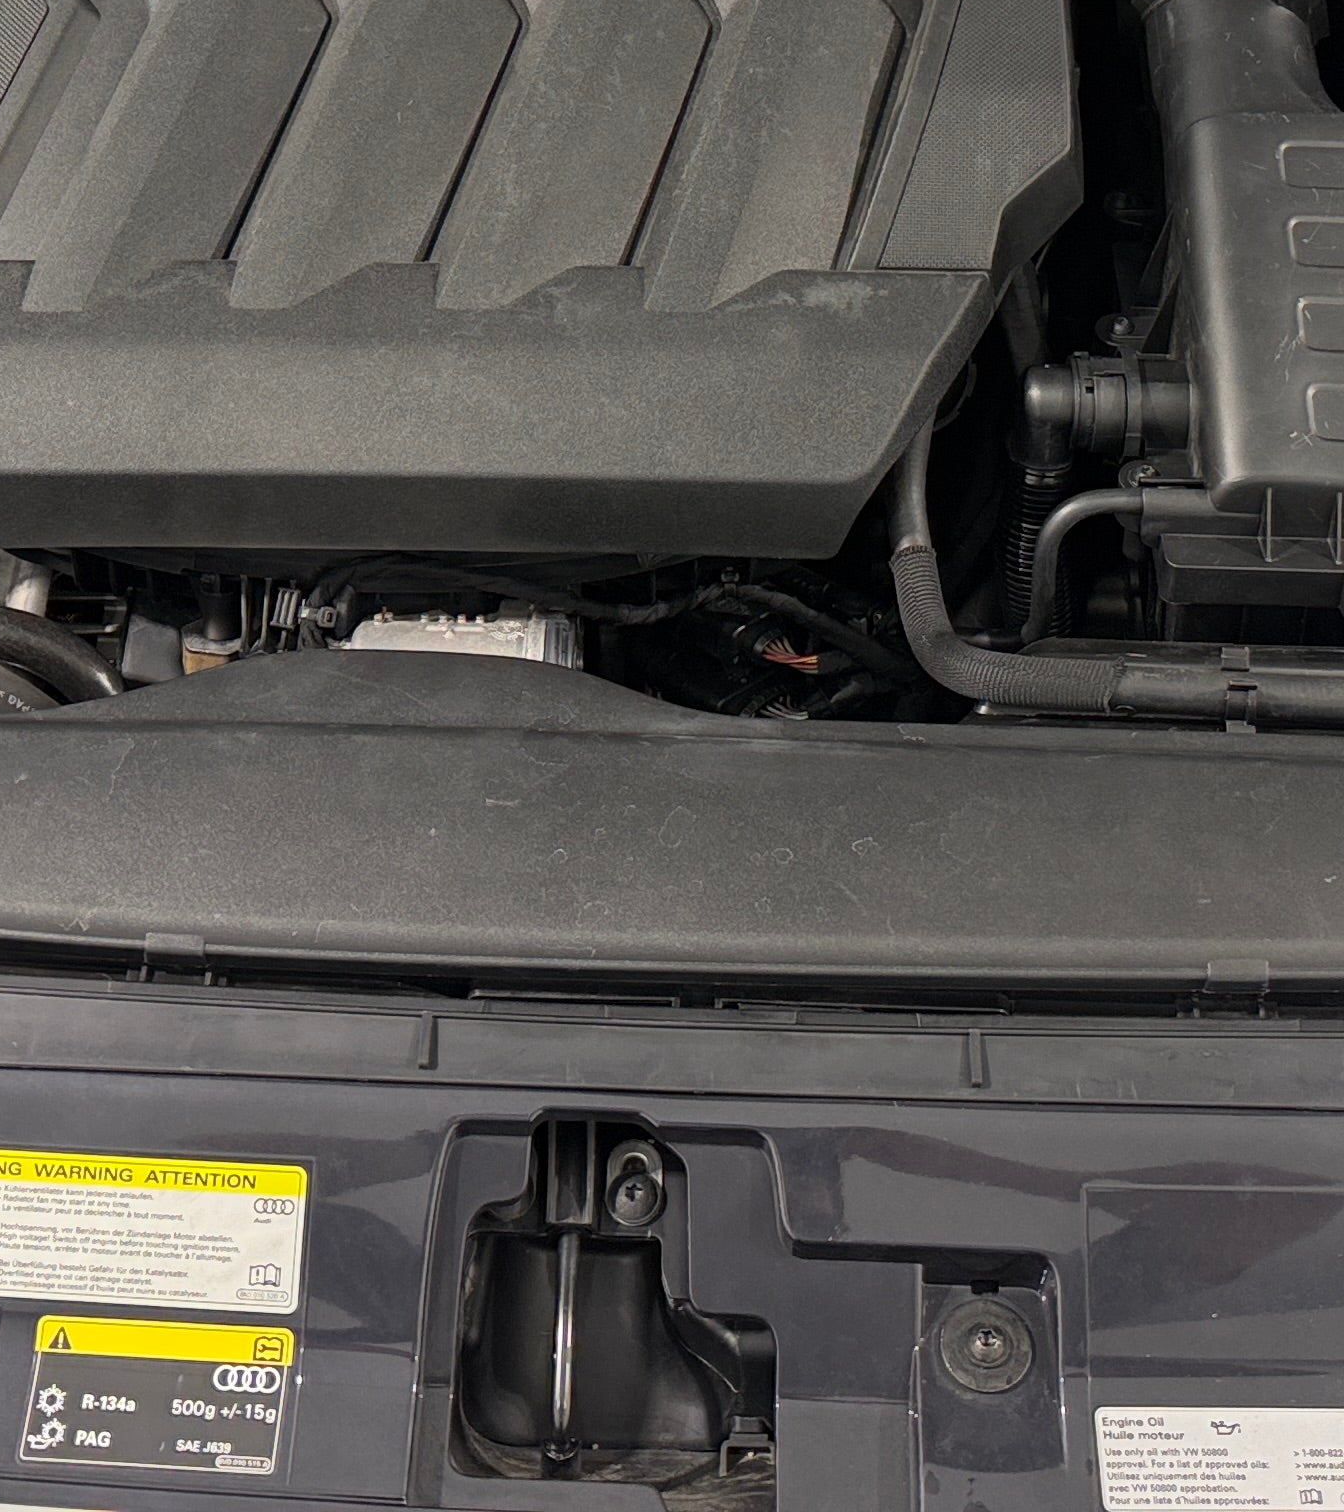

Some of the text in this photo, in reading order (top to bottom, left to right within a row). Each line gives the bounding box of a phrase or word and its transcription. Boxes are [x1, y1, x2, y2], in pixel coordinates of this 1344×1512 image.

[35, 1163, 133, 1182] WARNING
[144, 1170, 256, 1189] ATTENTION
[81, 1395, 136, 1413] R-134a
[171, 1398, 217, 1421] 500g
[1101, 1417, 1164, 1427] Engine Oil
[1102, 1430, 1185, 1440] Huile moteur
[74, 1430, 232, 1455] PAG SAE J639
[1124, 1447, 1144, 1457] only
[1160, 1448, 1180, 1456] with
[1182, 1448, 1199, 1456] VW
[1105, 1460, 1148, 1468] approval.
[1151, 1459, 1166, 1467] For
[1192, 1459, 1203, 1467] of
[1204, 1460, 1247, 1469] approved
[1249, 1460, 1269, 1468] oils:
[1106, 1472, 1246, 1481] Utilisez uniquement des huiles
[1131, 1483, 1148, 1491] VW
[1179, 1484, 1238, 1493] approbation.
[1152, 1496, 1172, 1504] liste
